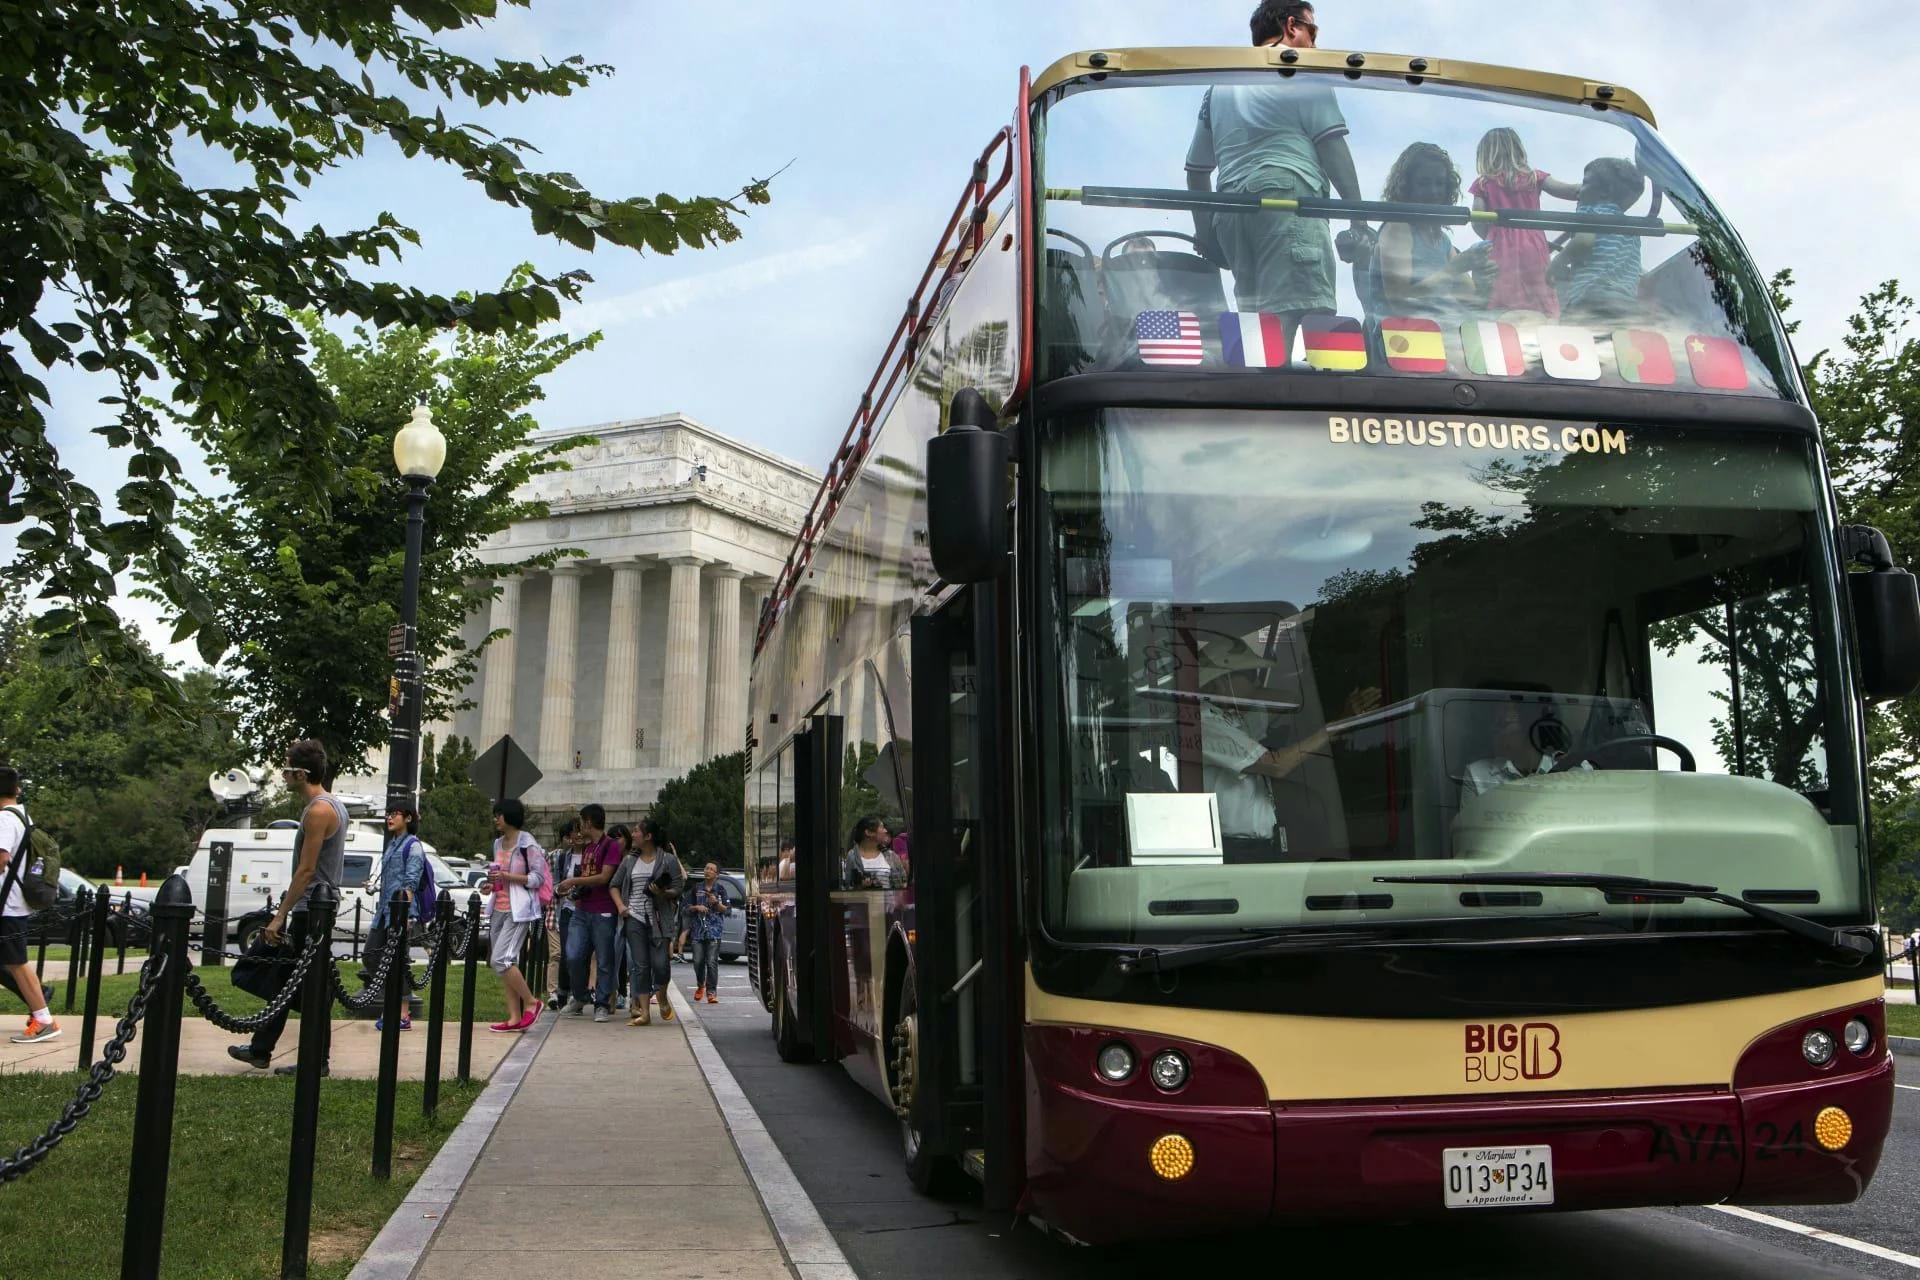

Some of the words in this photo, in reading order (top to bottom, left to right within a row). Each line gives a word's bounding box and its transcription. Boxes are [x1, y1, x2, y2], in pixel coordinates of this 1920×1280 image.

[1328, 416, 1627, 455] BIGBUSTOURS.COM
[1465, 1023, 1519, 1053] BIG
[1465, 1055, 1519, 1082] BUS
[1475, 1149, 1517, 1163] Maryland
[1648, 1123, 1739, 1162] AYA
[1755, 1121, 1803, 1161] 24
[1450, 1164, 1491, 1193] 013
[1507, 1162, 1548, 1192] P34
[1472, 1194, 1527, 1205] Apportioned
